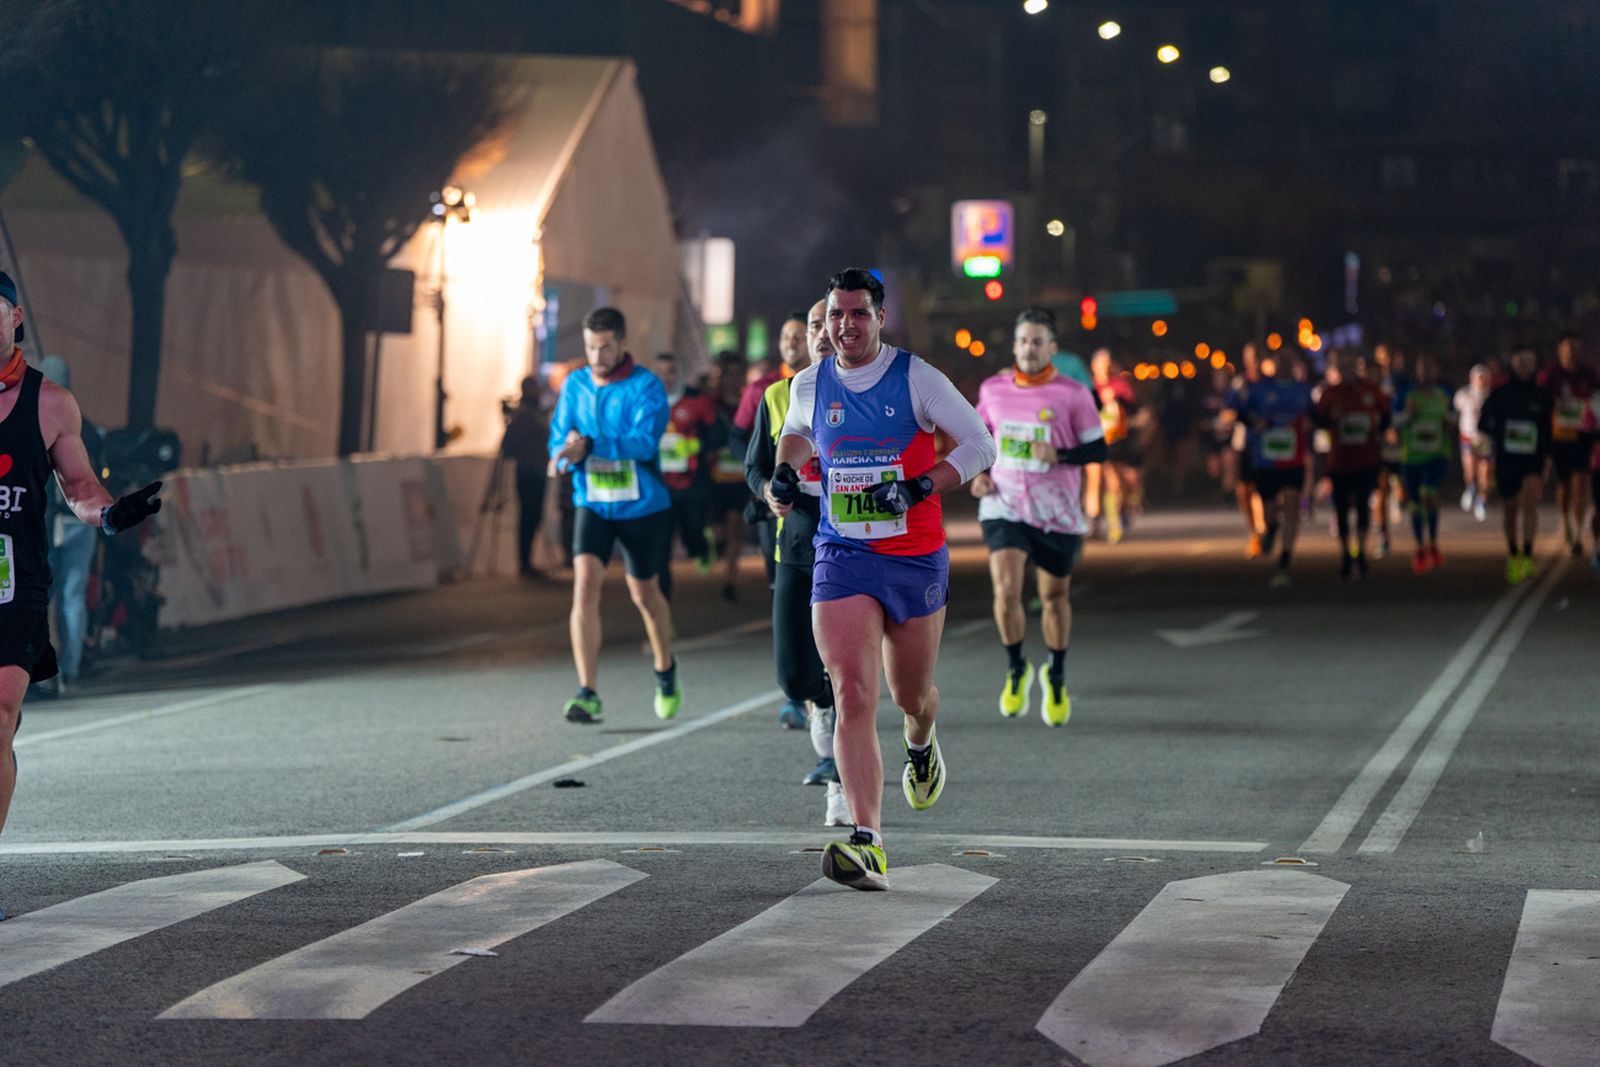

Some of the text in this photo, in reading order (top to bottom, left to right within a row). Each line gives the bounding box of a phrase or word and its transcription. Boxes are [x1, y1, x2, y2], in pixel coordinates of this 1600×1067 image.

[843, 475, 864, 483] NOCHE
[865, 475, 873, 483] DE
[835, 484, 849, 492] SAN
[844, 494, 885, 514] 714
